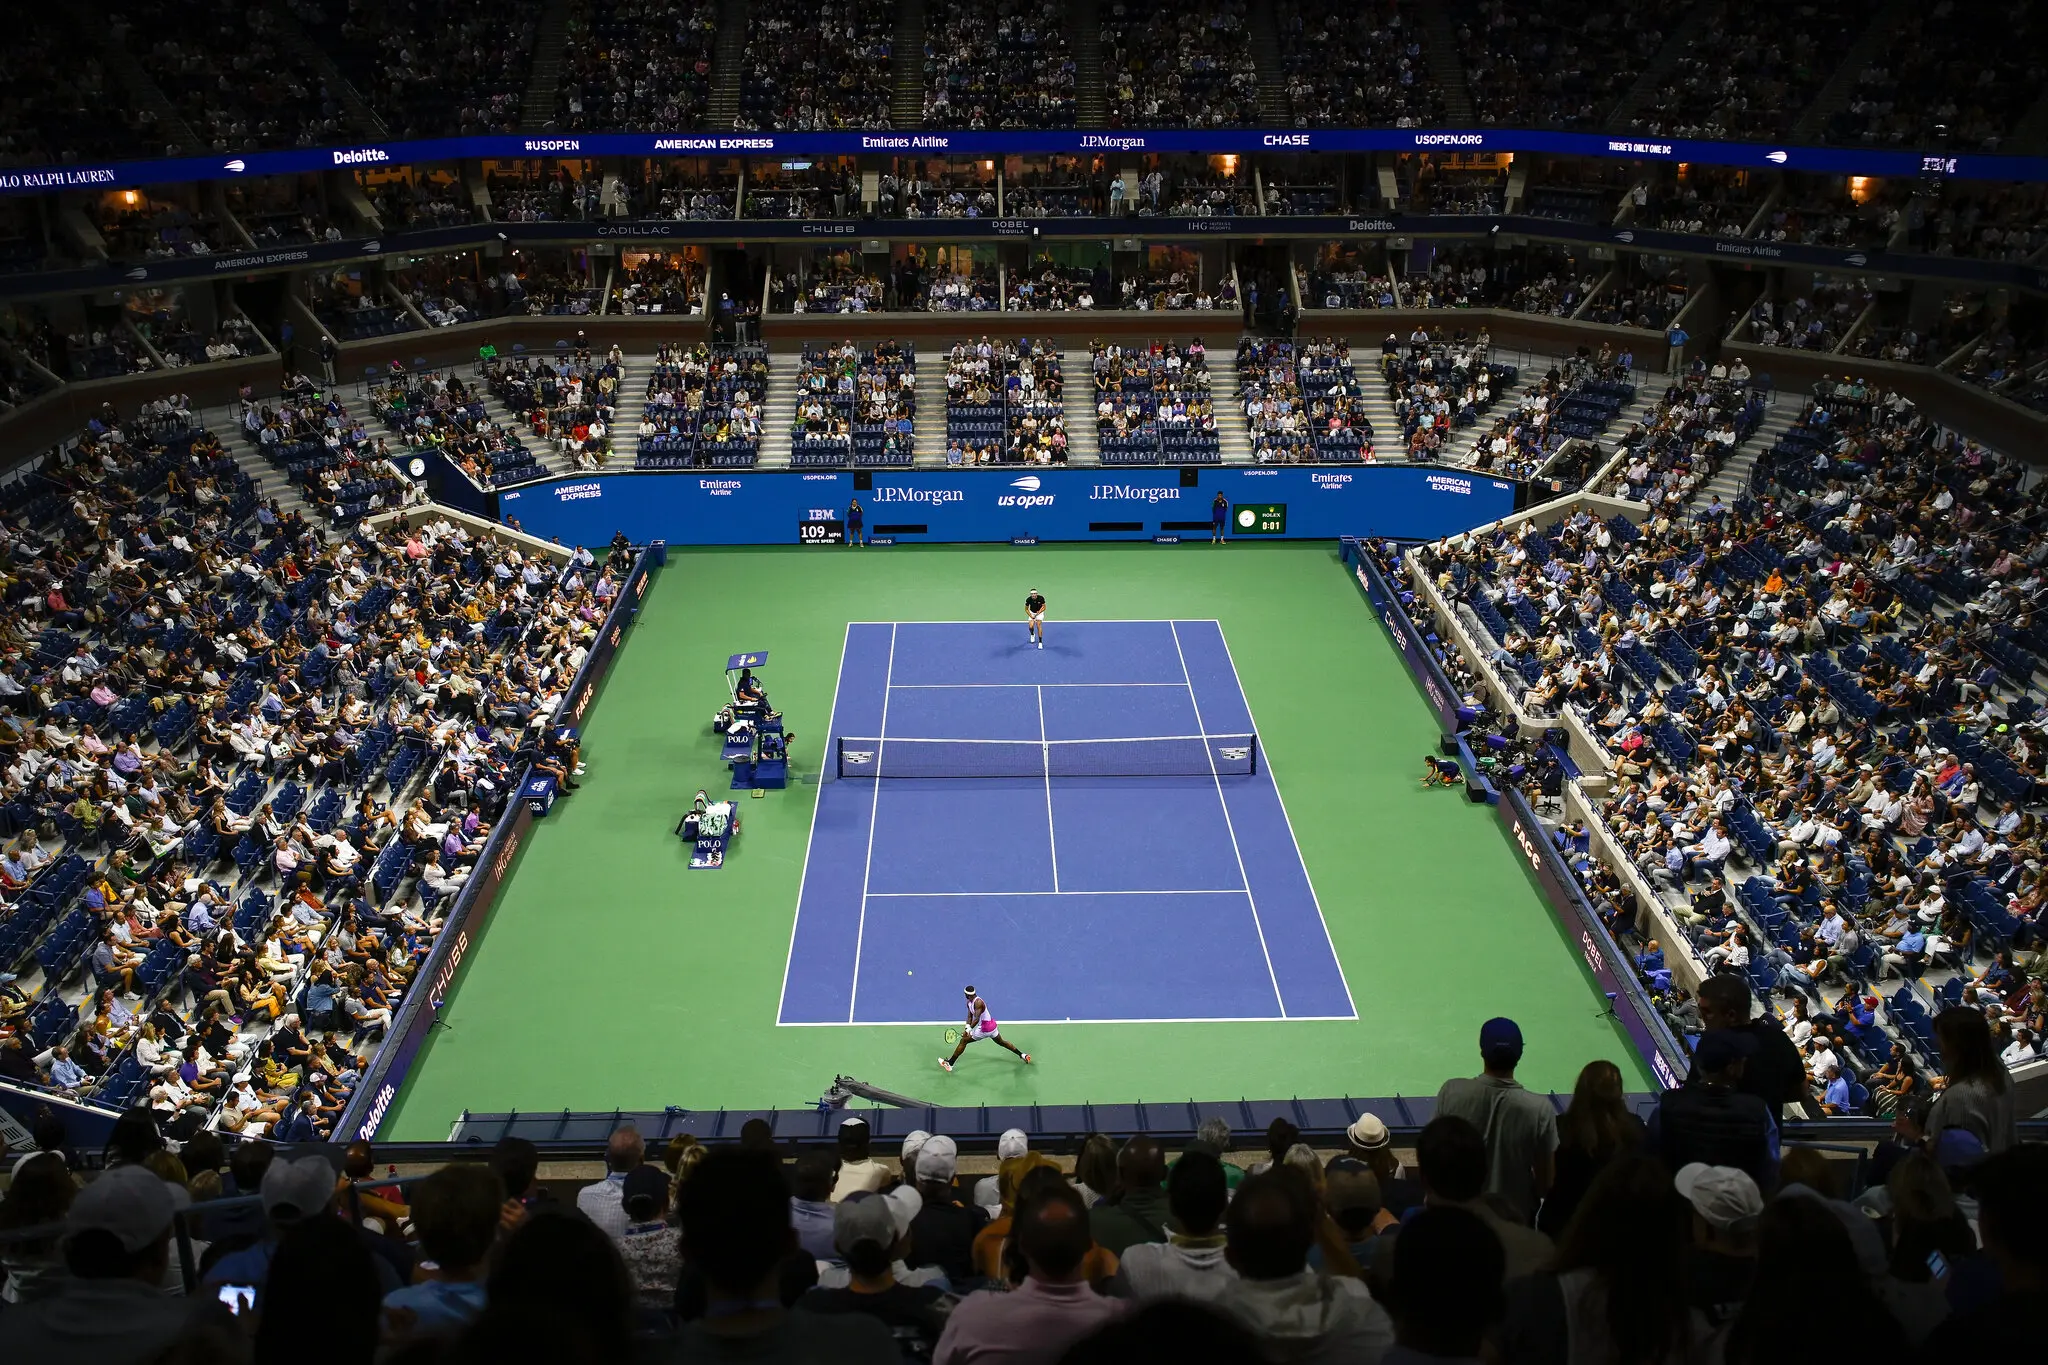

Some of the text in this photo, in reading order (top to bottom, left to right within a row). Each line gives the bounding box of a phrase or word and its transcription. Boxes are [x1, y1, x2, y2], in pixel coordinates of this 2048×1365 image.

[525, 140, 580, 151] #USOPEN
[654, 138, 774, 149] AMERICAN EXPRESS
[862, 136, 948, 148] Emirates Airline
[1079, 136, 1145, 150] J.P.Morgan
[1263, 134, 1310, 146] CHASE
[1415, 135, 1483, 145] USOPEN.ORG
[1633, 143, 1649, 153] ONLY
[1649, 144, 1662, 154] ONE
[1662, 145, 1671, 154] DC
[333, 148, 389, 165] Deloitte.
[22, 171, 65, 187] RALPH
[67, 169, 115, 184] LAUREN
[597, 226, 670, 235] CADILLAC
[802, 225, 855, 233] CHUBB
[992, 220, 1029, 229] DOBEL
[1188, 222, 1208, 231] IHG
[1350, 220, 1395, 230] Deloitte.
[1716, 242, 1782, 257] Emirates Airline
[214, 251, 308, 270] AMERICAN EXPRESS
[699, 479, 742, 489] Emirates
[1311, 473, 1353, 483] Emirates
[1426, 475, 1471, 488] AMERICAN
[554, 483, 601, 496] AMERICAN
[1432, 483, 1471, 495] EXPRESS
[1492, 481, 1509, 490] USTA
[504, 492, 521, 501] USTA
[561, 490, 602, 501] EXPRESS
[872, 487, 964, 506] J.P.Morgan
[1089, 485, 1180, 503] J.P.Morgan
[998, 495, 1054, 509] us open
[808, 509, 835, 521] IBM
[801, 525, 826, 538] 109
[1262, 521, 1280, 530] 0:01
[1384, 611, 1407, 651] CHUBB
[727, 735, 749, 743] POLO
[697, 840, 721, 848] POLO
[1582, 931, 1603, 970] DOBEL
[429, 931, 468, 1010] CHUBB
